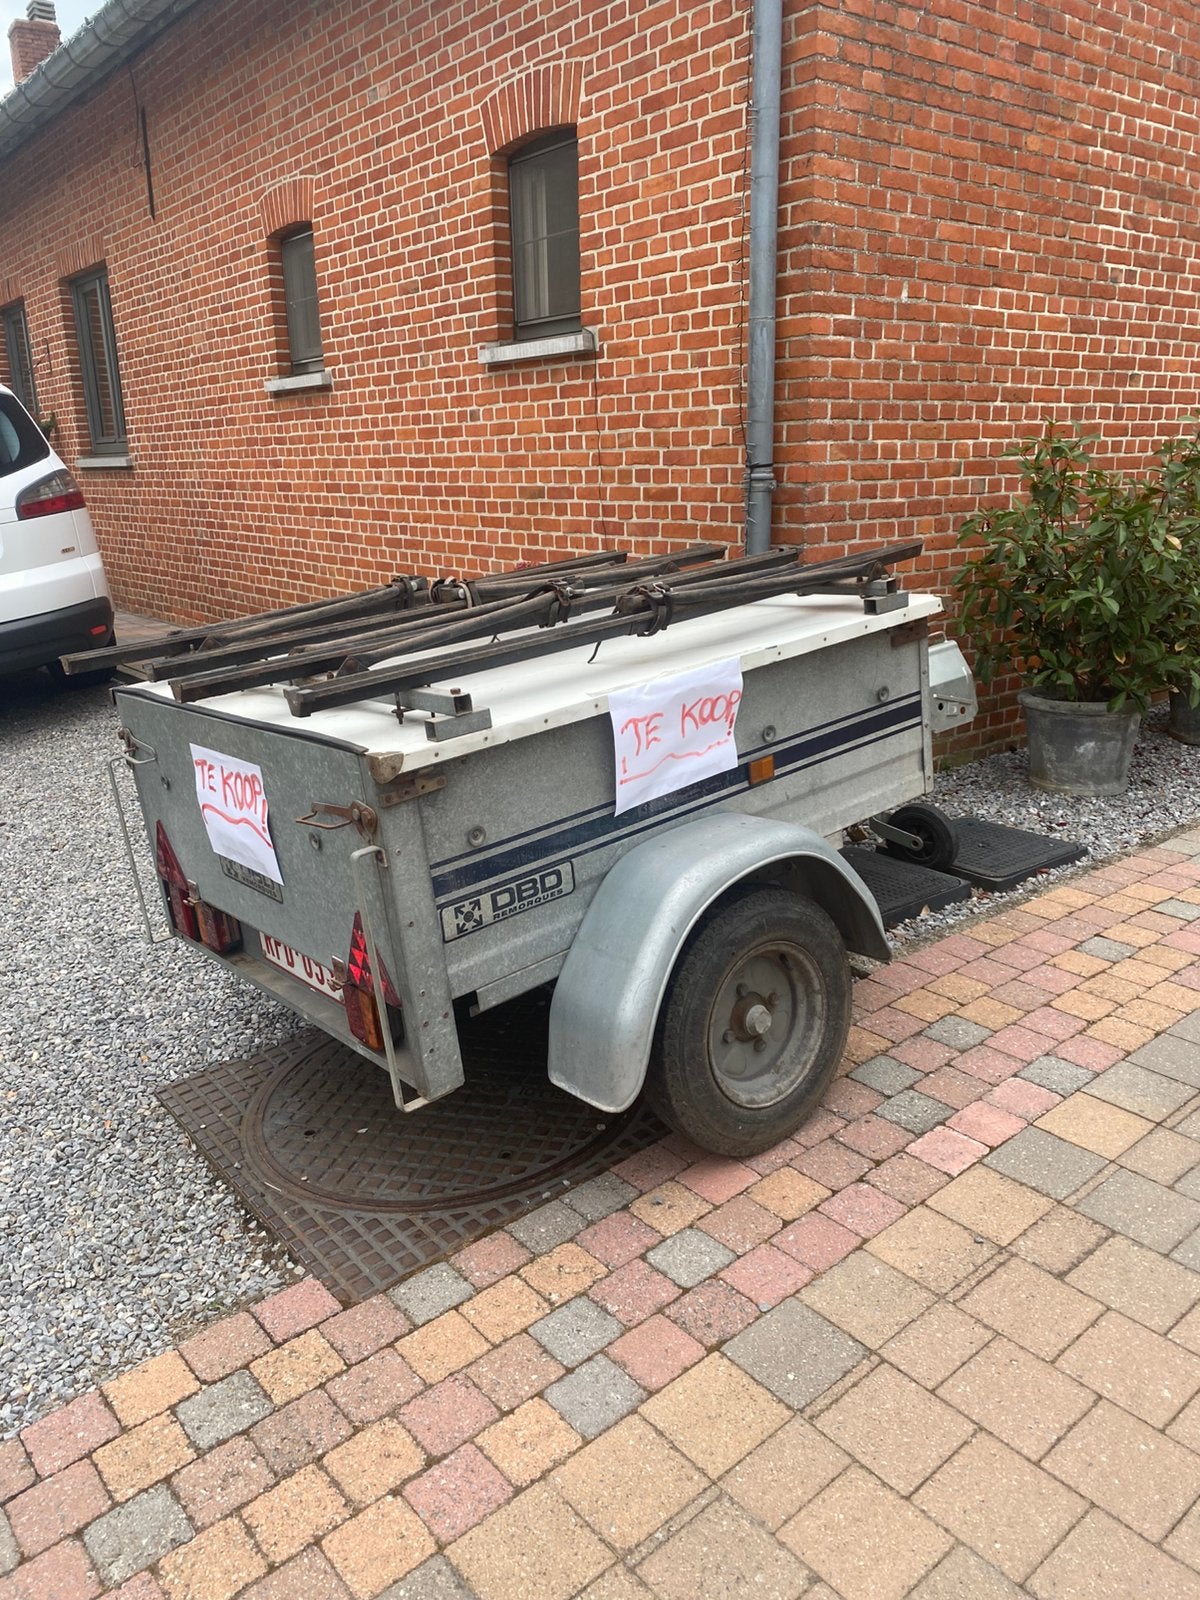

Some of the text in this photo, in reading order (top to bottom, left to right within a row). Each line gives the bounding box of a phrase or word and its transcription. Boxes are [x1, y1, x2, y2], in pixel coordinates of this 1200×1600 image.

[620, 712, 664, 756] TE
[194, 759, 267, 833] TE KOOP!
[490, 868, 563, 914] DBD
[493, 888, 564, 921] REMORQUES
